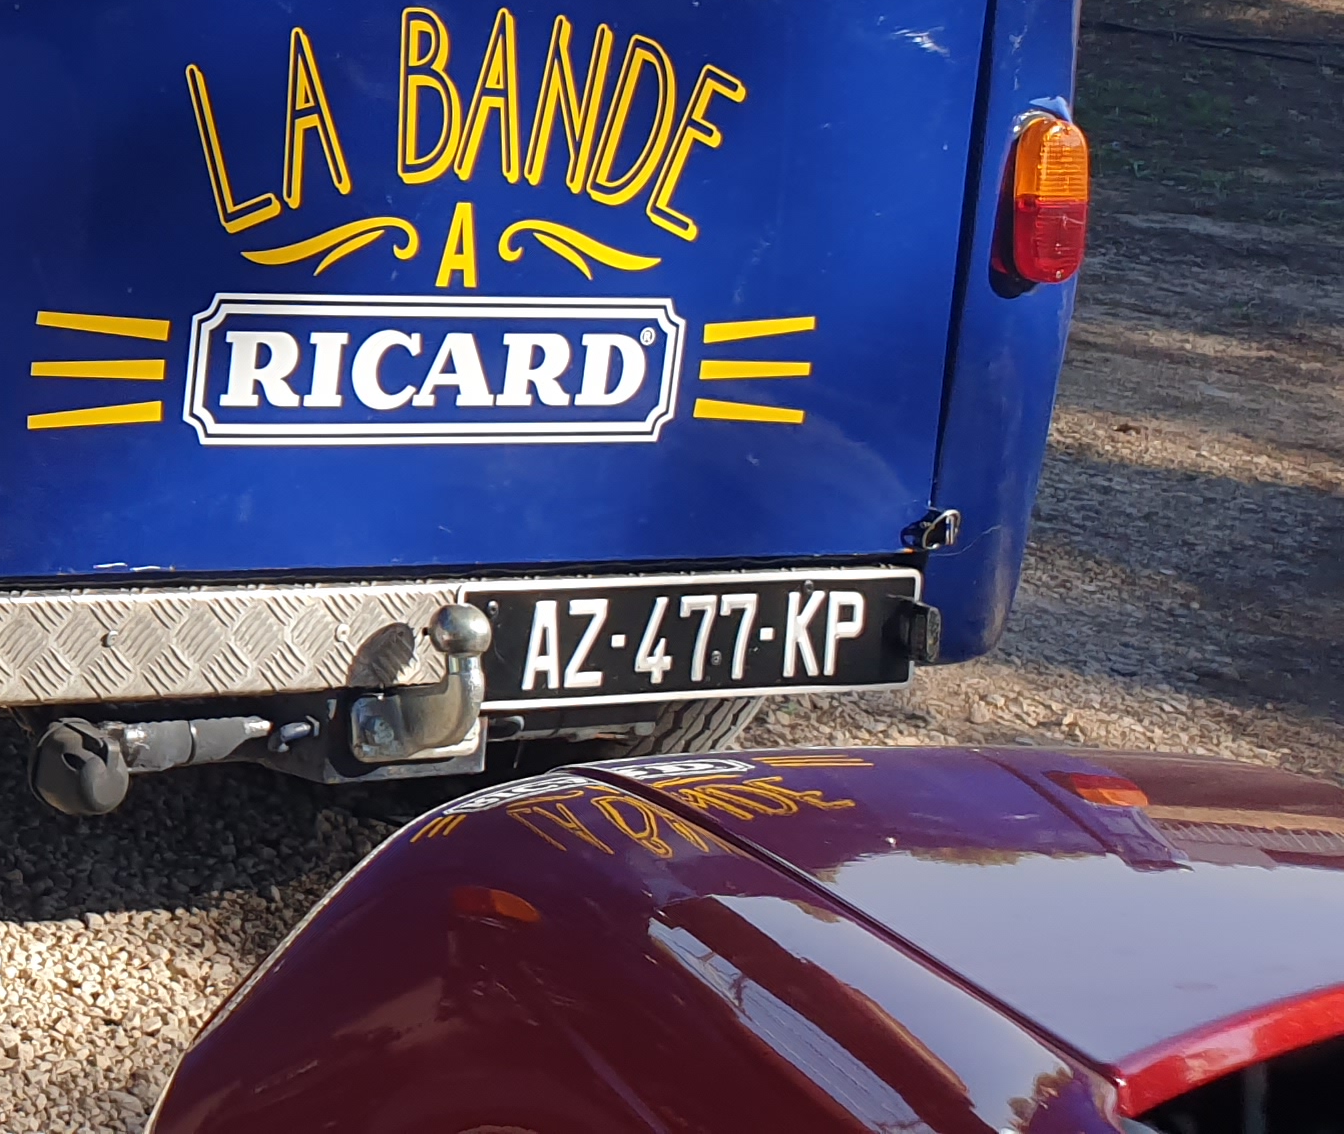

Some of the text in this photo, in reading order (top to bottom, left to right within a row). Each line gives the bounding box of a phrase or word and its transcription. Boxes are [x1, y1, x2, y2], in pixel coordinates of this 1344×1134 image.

[185, 6, 746, 241] LA BANDE
[435, 201, 478, 288] A
[219, 328, 648, 409] RICARD
[521, 590, 865, 691] AZ-477-KP
